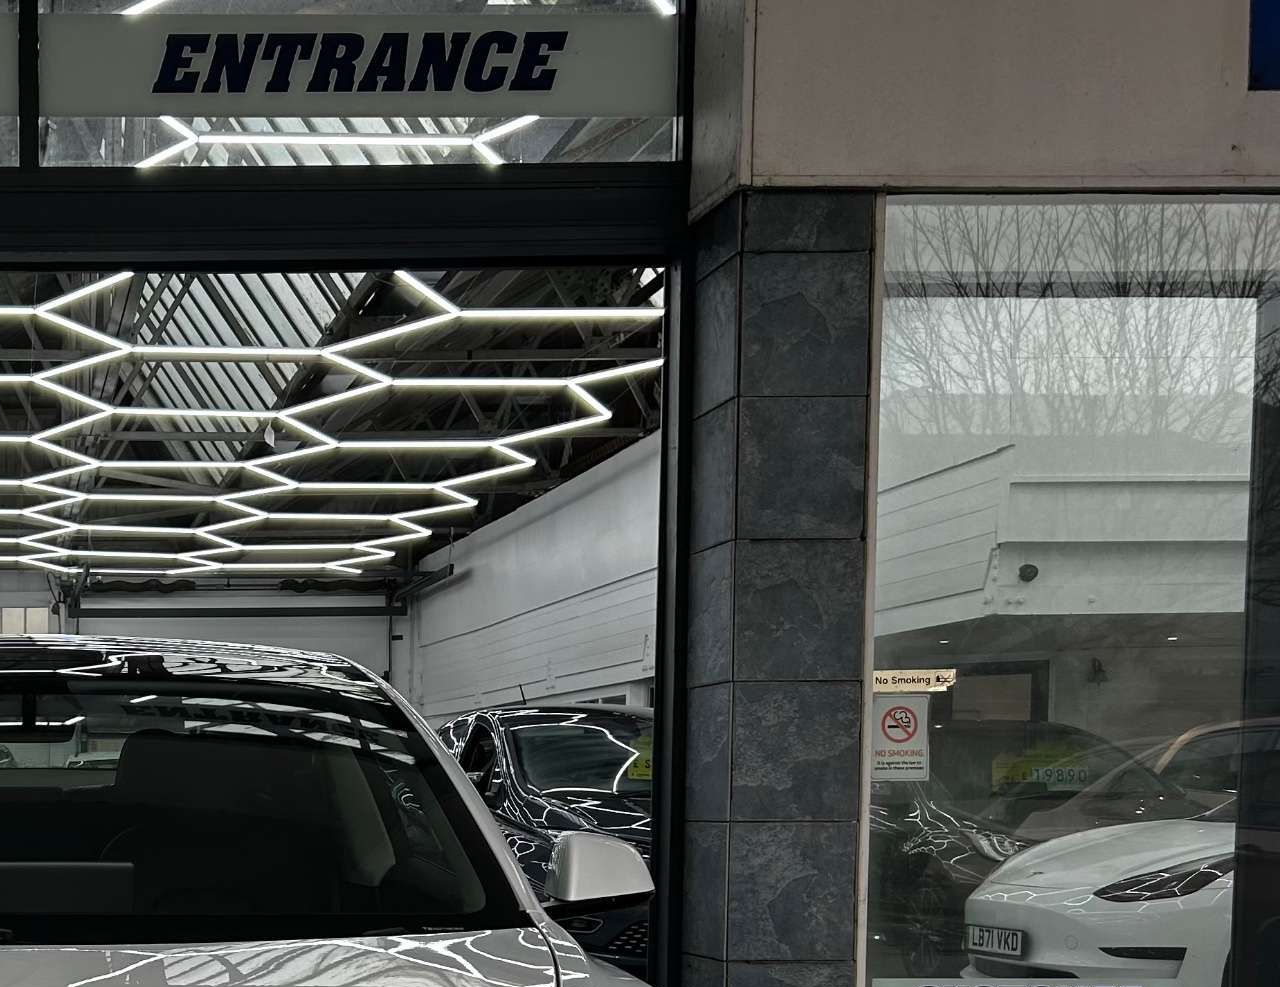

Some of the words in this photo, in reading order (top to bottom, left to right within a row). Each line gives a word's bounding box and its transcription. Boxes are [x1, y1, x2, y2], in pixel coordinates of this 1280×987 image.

[151, 30, 569, 94] ENTRANCE
[875, 676, 889, 685] No
[891, 675, 932, 686] Smoking
[875, 749, 886, 757] NO
[888, 749, 924, 757] SMOKING
[972, 927, 994, 949] LB71
[997, 928, 1019, 952] VKD
